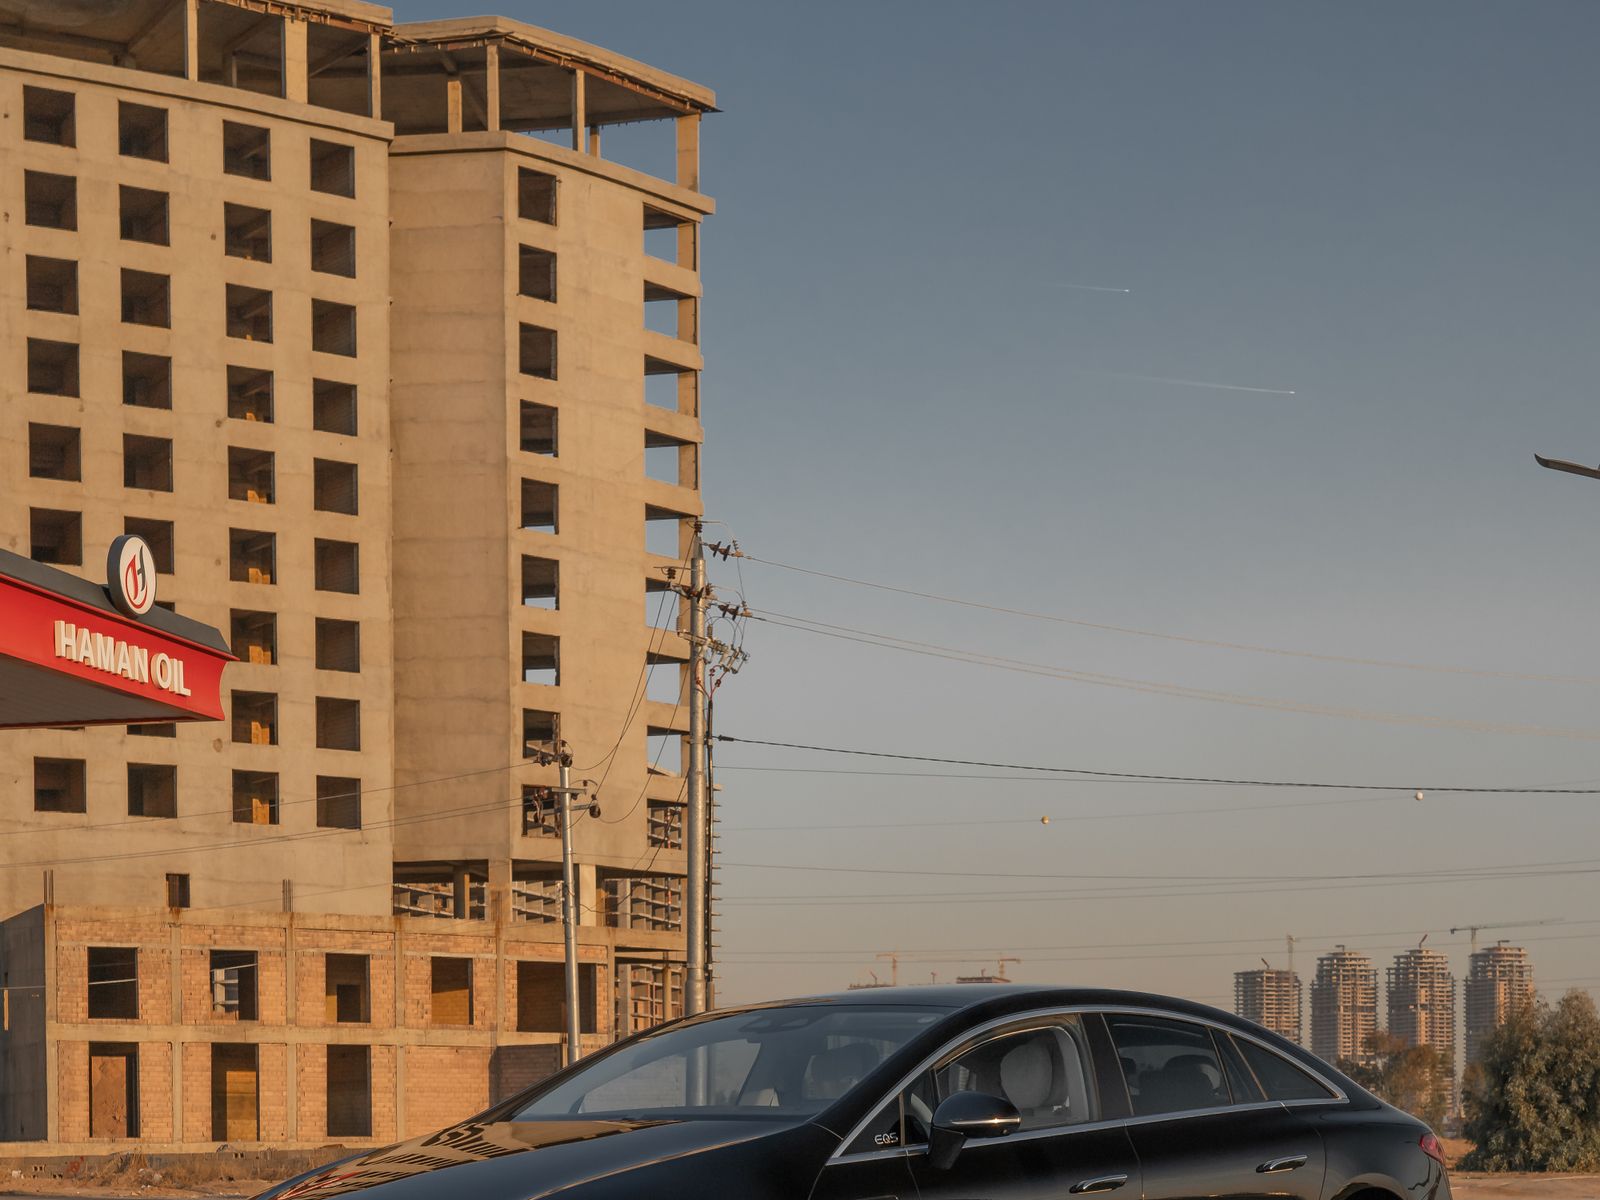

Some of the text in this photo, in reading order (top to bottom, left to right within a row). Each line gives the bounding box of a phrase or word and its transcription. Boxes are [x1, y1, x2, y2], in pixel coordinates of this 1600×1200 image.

[54, 620, 192, 697] HAMAN OIL
[874, 1132, 899, 1145] EQS
